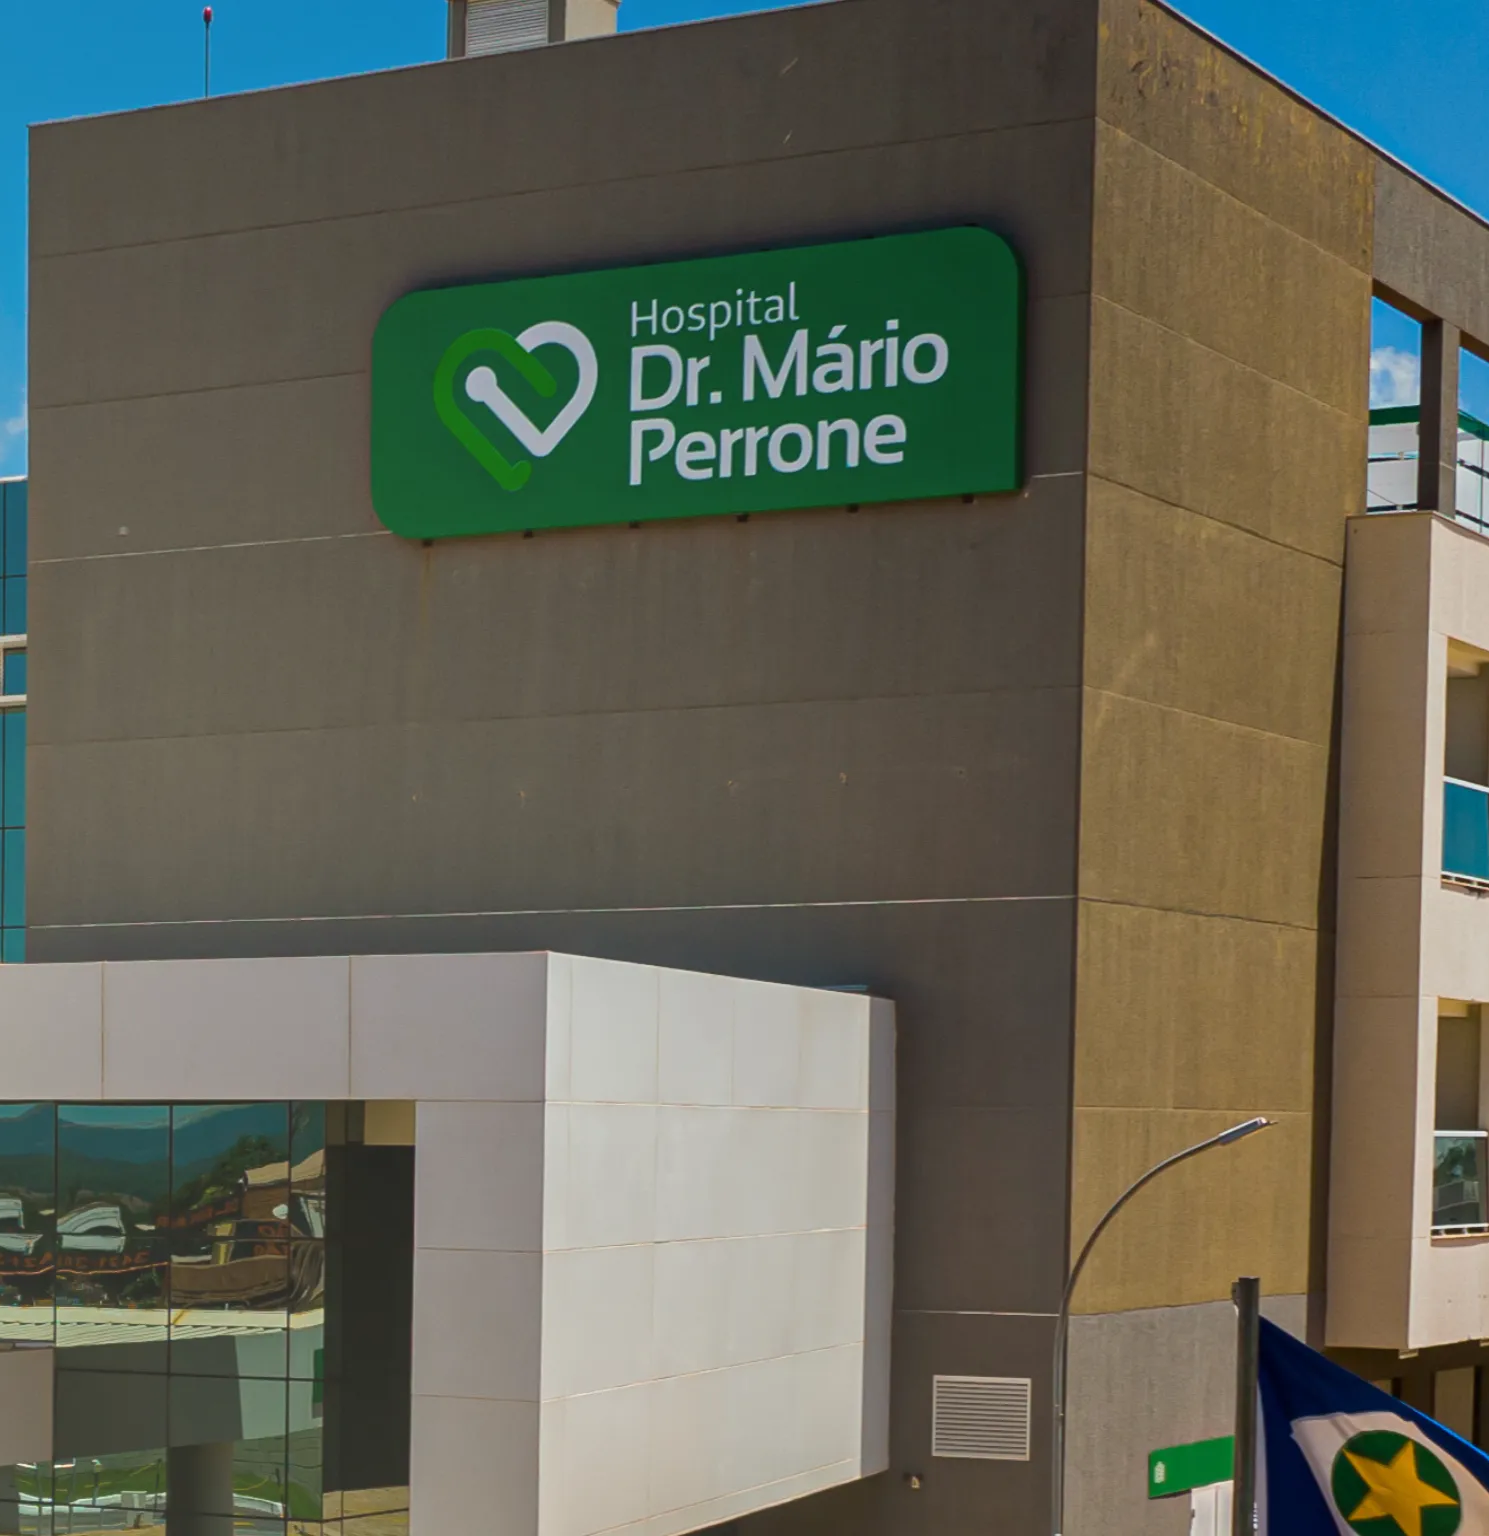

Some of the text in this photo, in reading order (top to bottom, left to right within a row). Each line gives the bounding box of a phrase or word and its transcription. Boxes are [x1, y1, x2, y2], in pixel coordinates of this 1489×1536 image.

[631, 281, 800, 341] Hospital
[630, 319, 950, 412] Dr. Mário
[629, 414, 908, 486] Perrone
